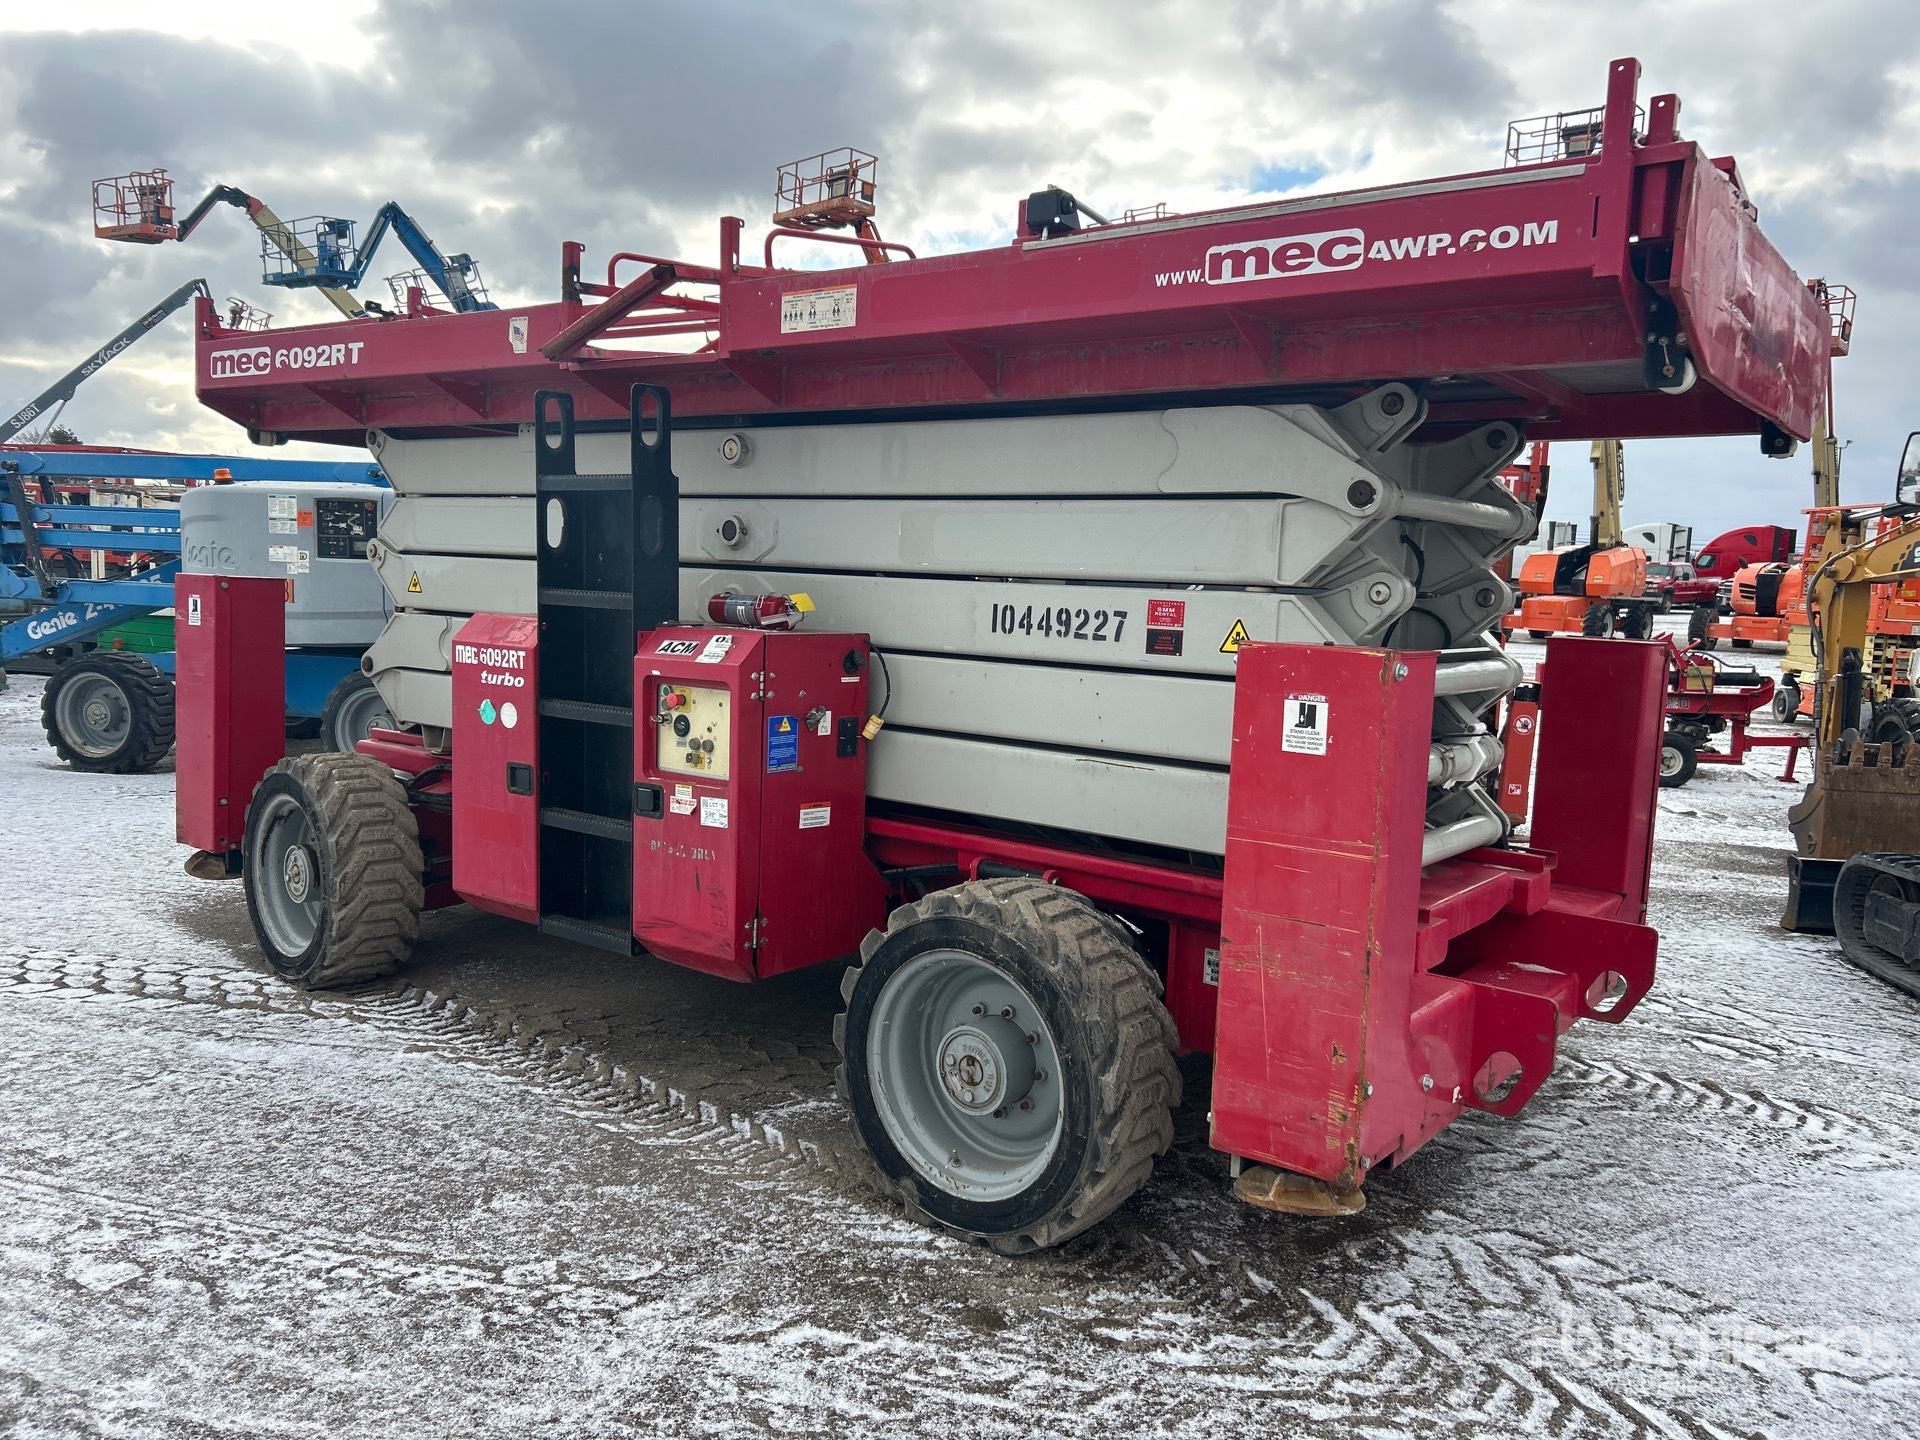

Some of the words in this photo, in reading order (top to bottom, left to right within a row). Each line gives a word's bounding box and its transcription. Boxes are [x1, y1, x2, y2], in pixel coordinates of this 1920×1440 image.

[81, 337, 131, 377] SKYJACK
[211, 347, 271, 378] mec
[275, 342, 364, 369] 6092RT
[10, 402, 41, 430] SJ86T
[27, 611, 78, 640] Genie
[991, 603, 1128, 643] 10449227
[479, 648, 526, 669] 6092RT
[658, 641, 700, 654] ACM
[480, 670, 525, 688] turbo
[1298, 694, 1326, 702] DANGER
